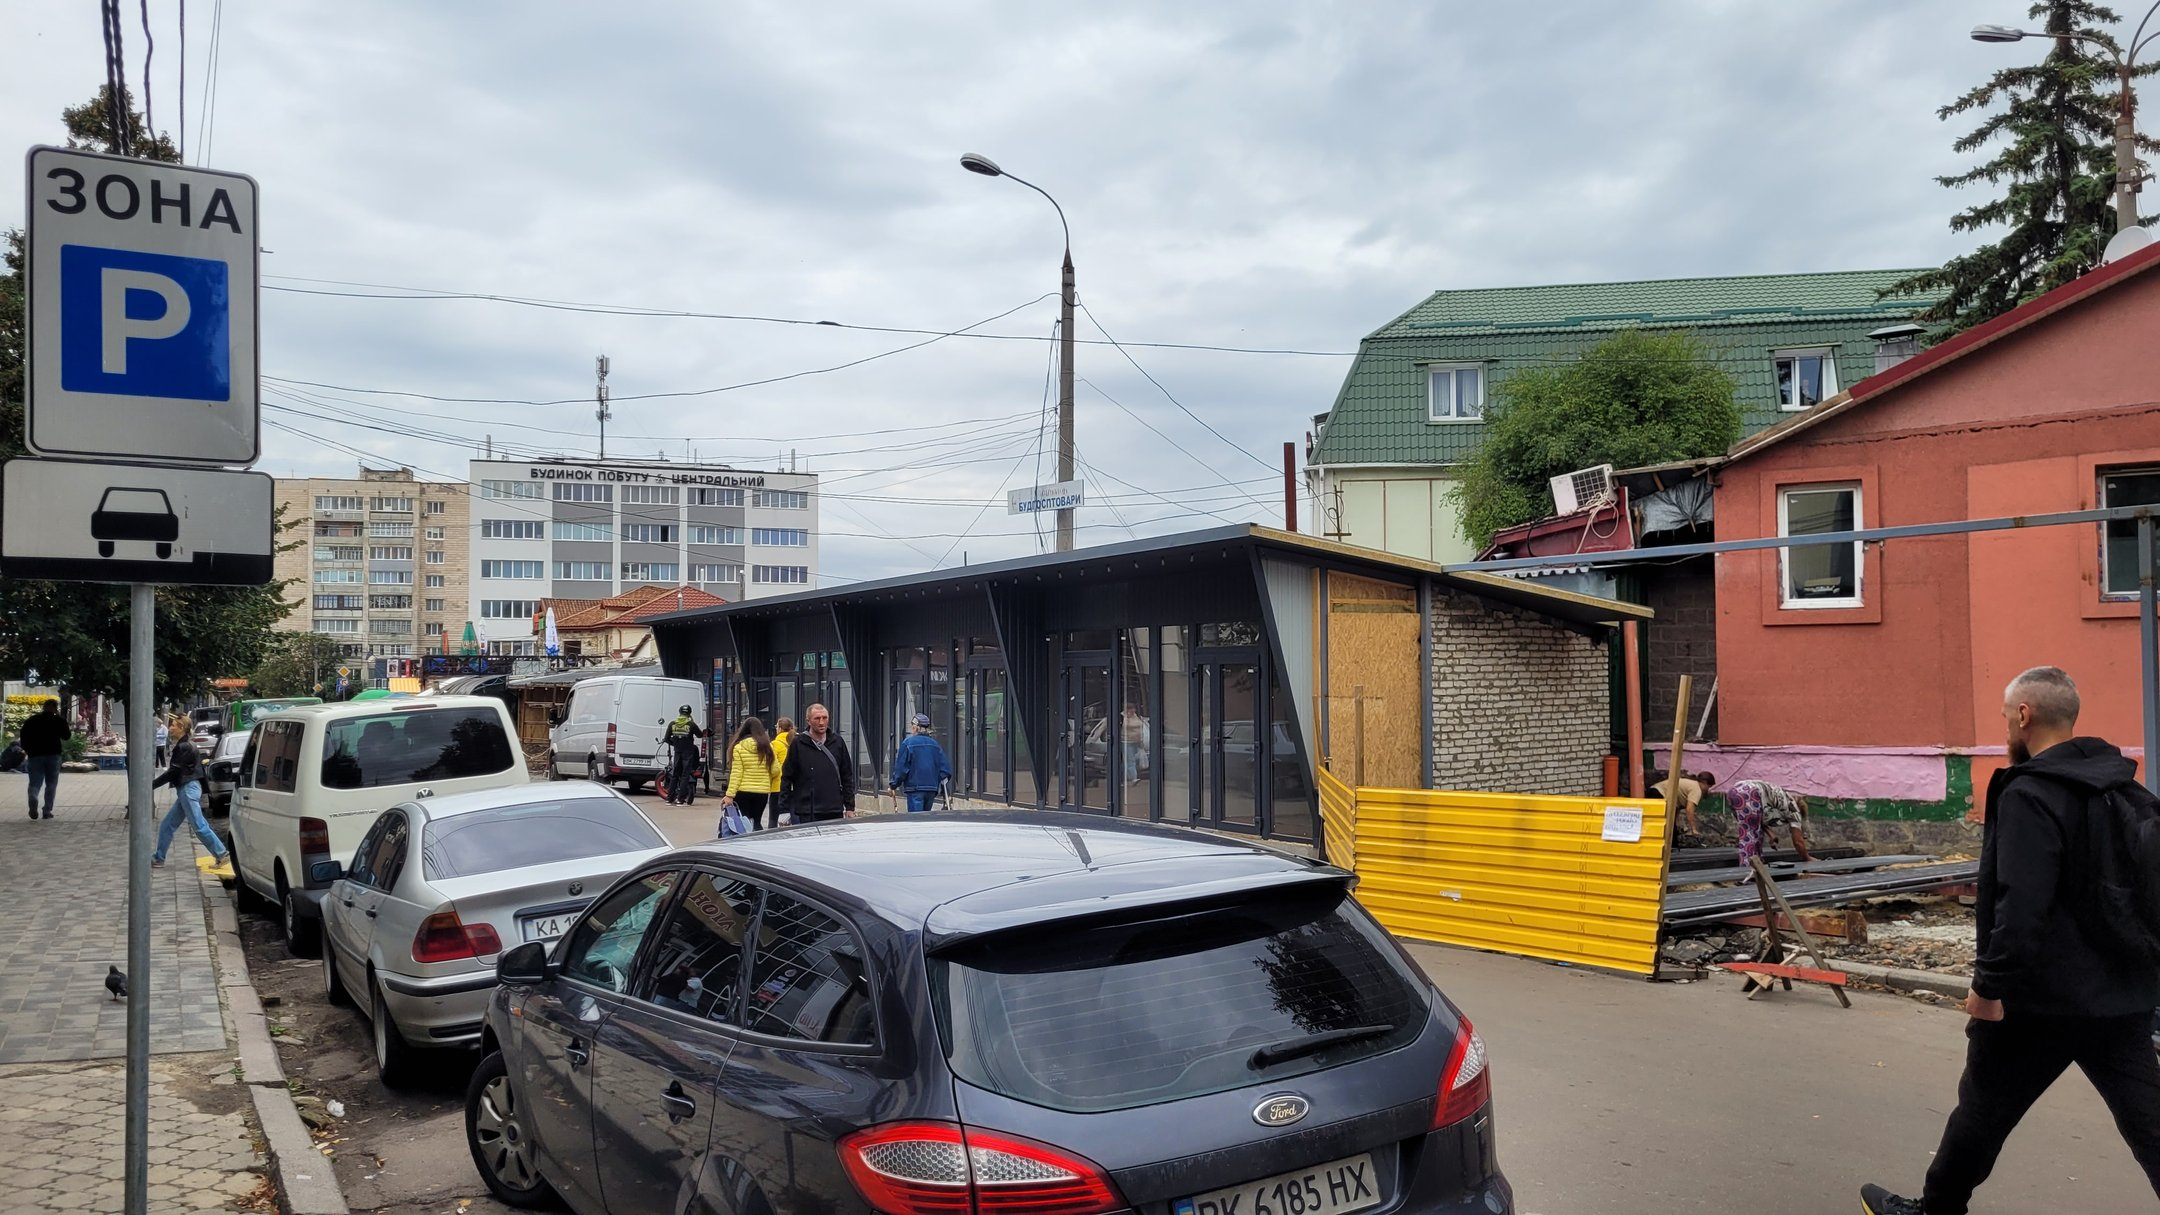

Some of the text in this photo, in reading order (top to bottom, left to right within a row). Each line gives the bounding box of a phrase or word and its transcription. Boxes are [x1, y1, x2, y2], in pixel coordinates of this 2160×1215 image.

[47, 168, 242, 234] ЗОНА
[102, 267, 191, 374] P
[530, 467, 765, 487] БУДИНОК ПОБУТУ ЦЕНТРАЛЬНИЙ
[535, 915, 579, 937] KA 1
[1269, 1102, 1297, 1120] Ford
[1255, 1174, 1321, 1215] 6185
[1326, 1161, 1371, 1206] HX
